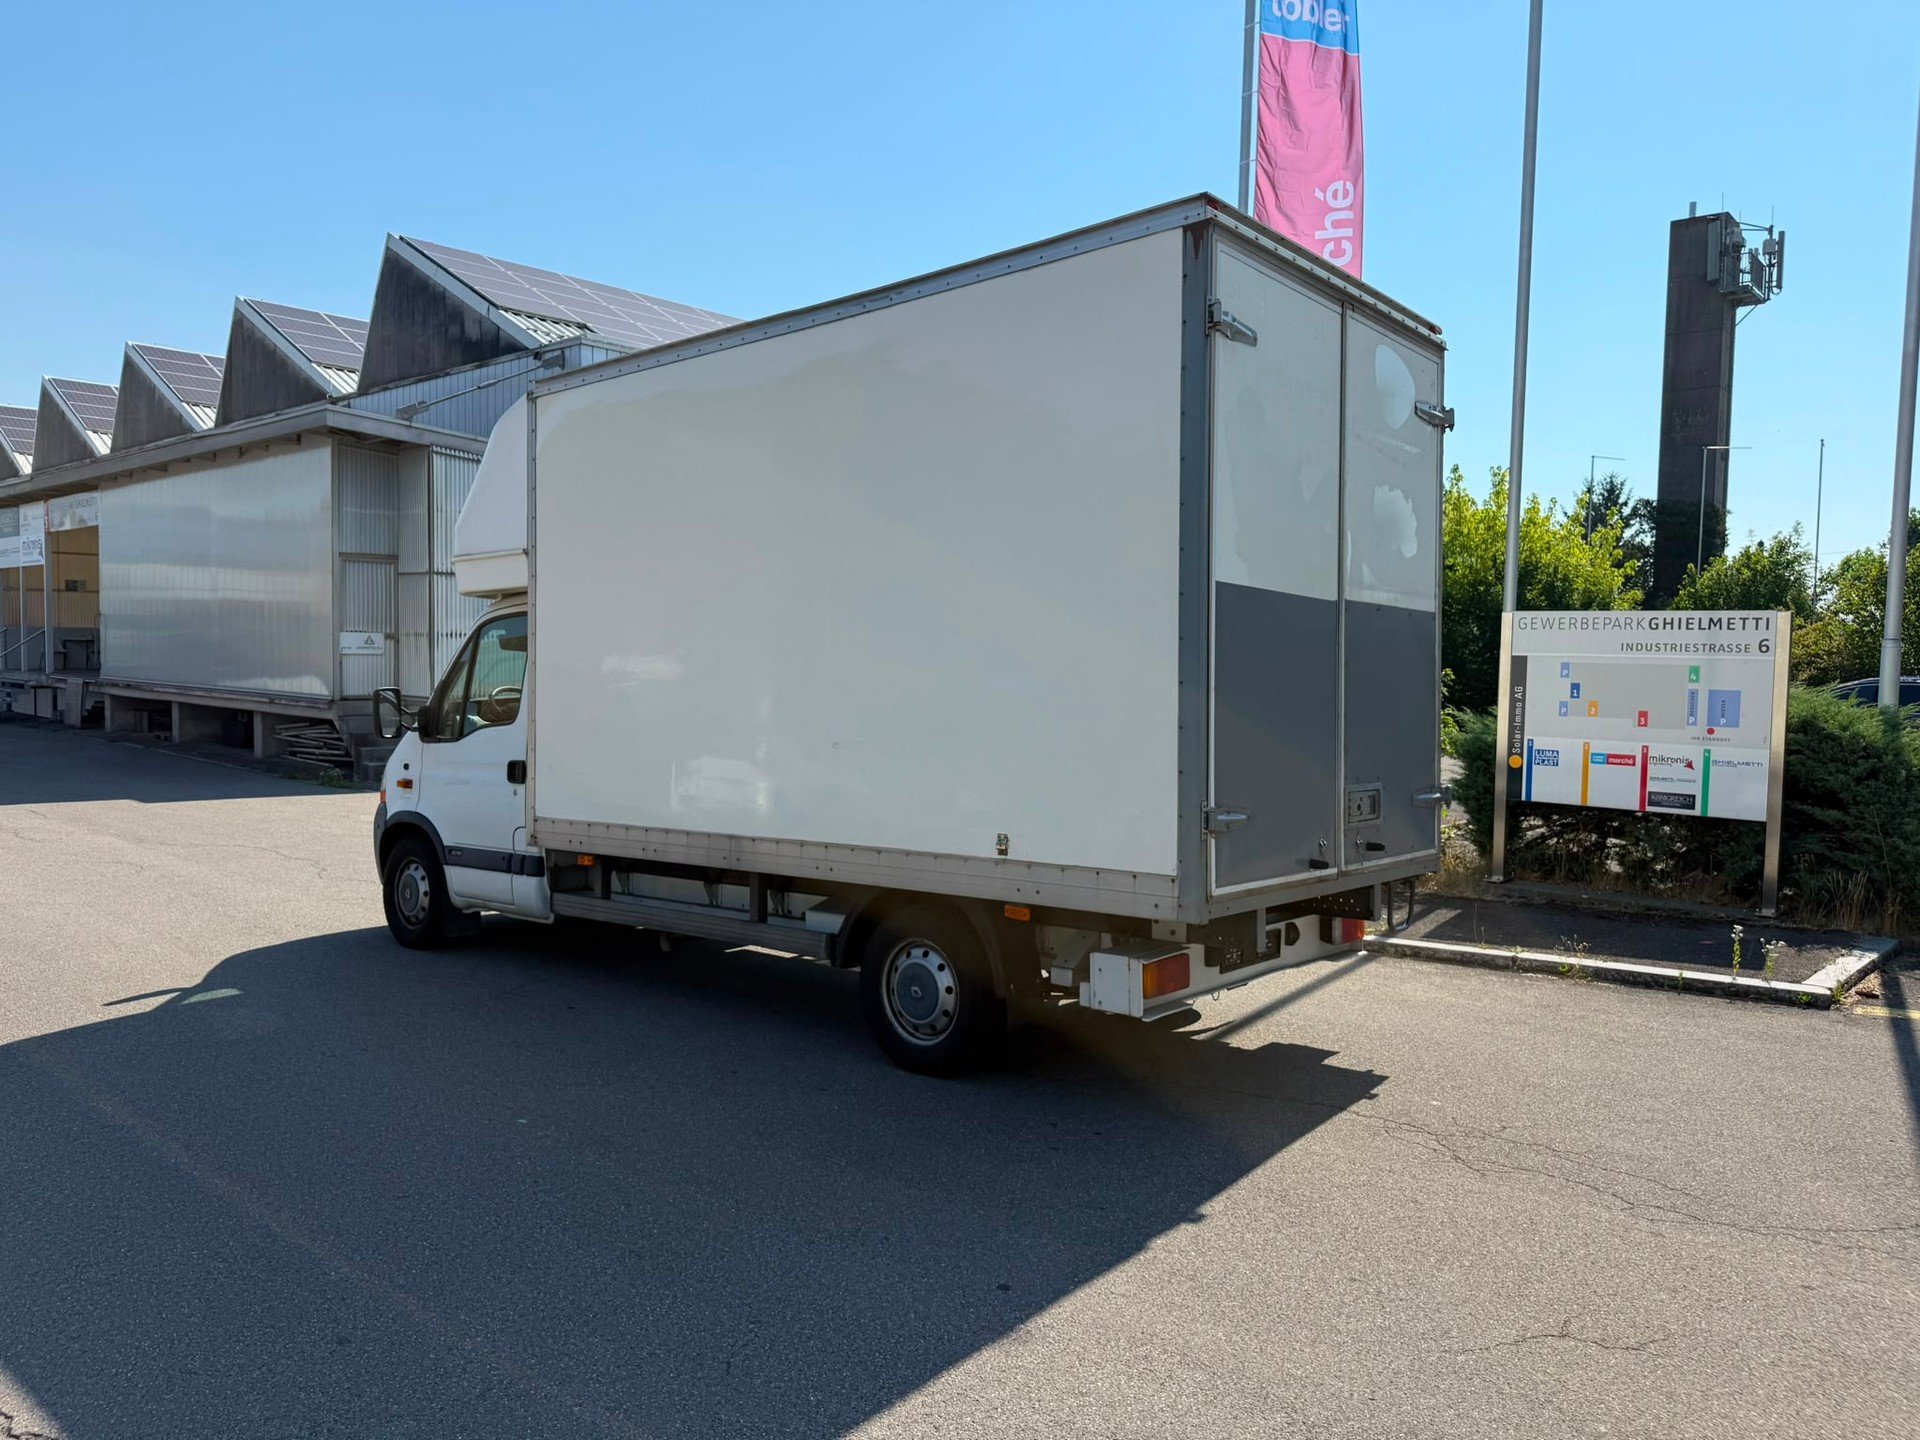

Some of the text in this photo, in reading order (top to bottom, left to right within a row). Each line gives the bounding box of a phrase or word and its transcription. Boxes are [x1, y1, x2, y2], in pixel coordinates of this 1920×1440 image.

[1620, 638, 1770, 654] INDUSTRIESTRASSE 6
[1690, 672, 1697, 681] 4
[1572, 689, 1578, 697] 1
[1512, 686, 1523, 753] Solar-Immo AG
[1639, 717, 1646, 725] 3
[1535, 758, 1558, 766] PLAST
[1649, 754, 1690, 764] mikronis
